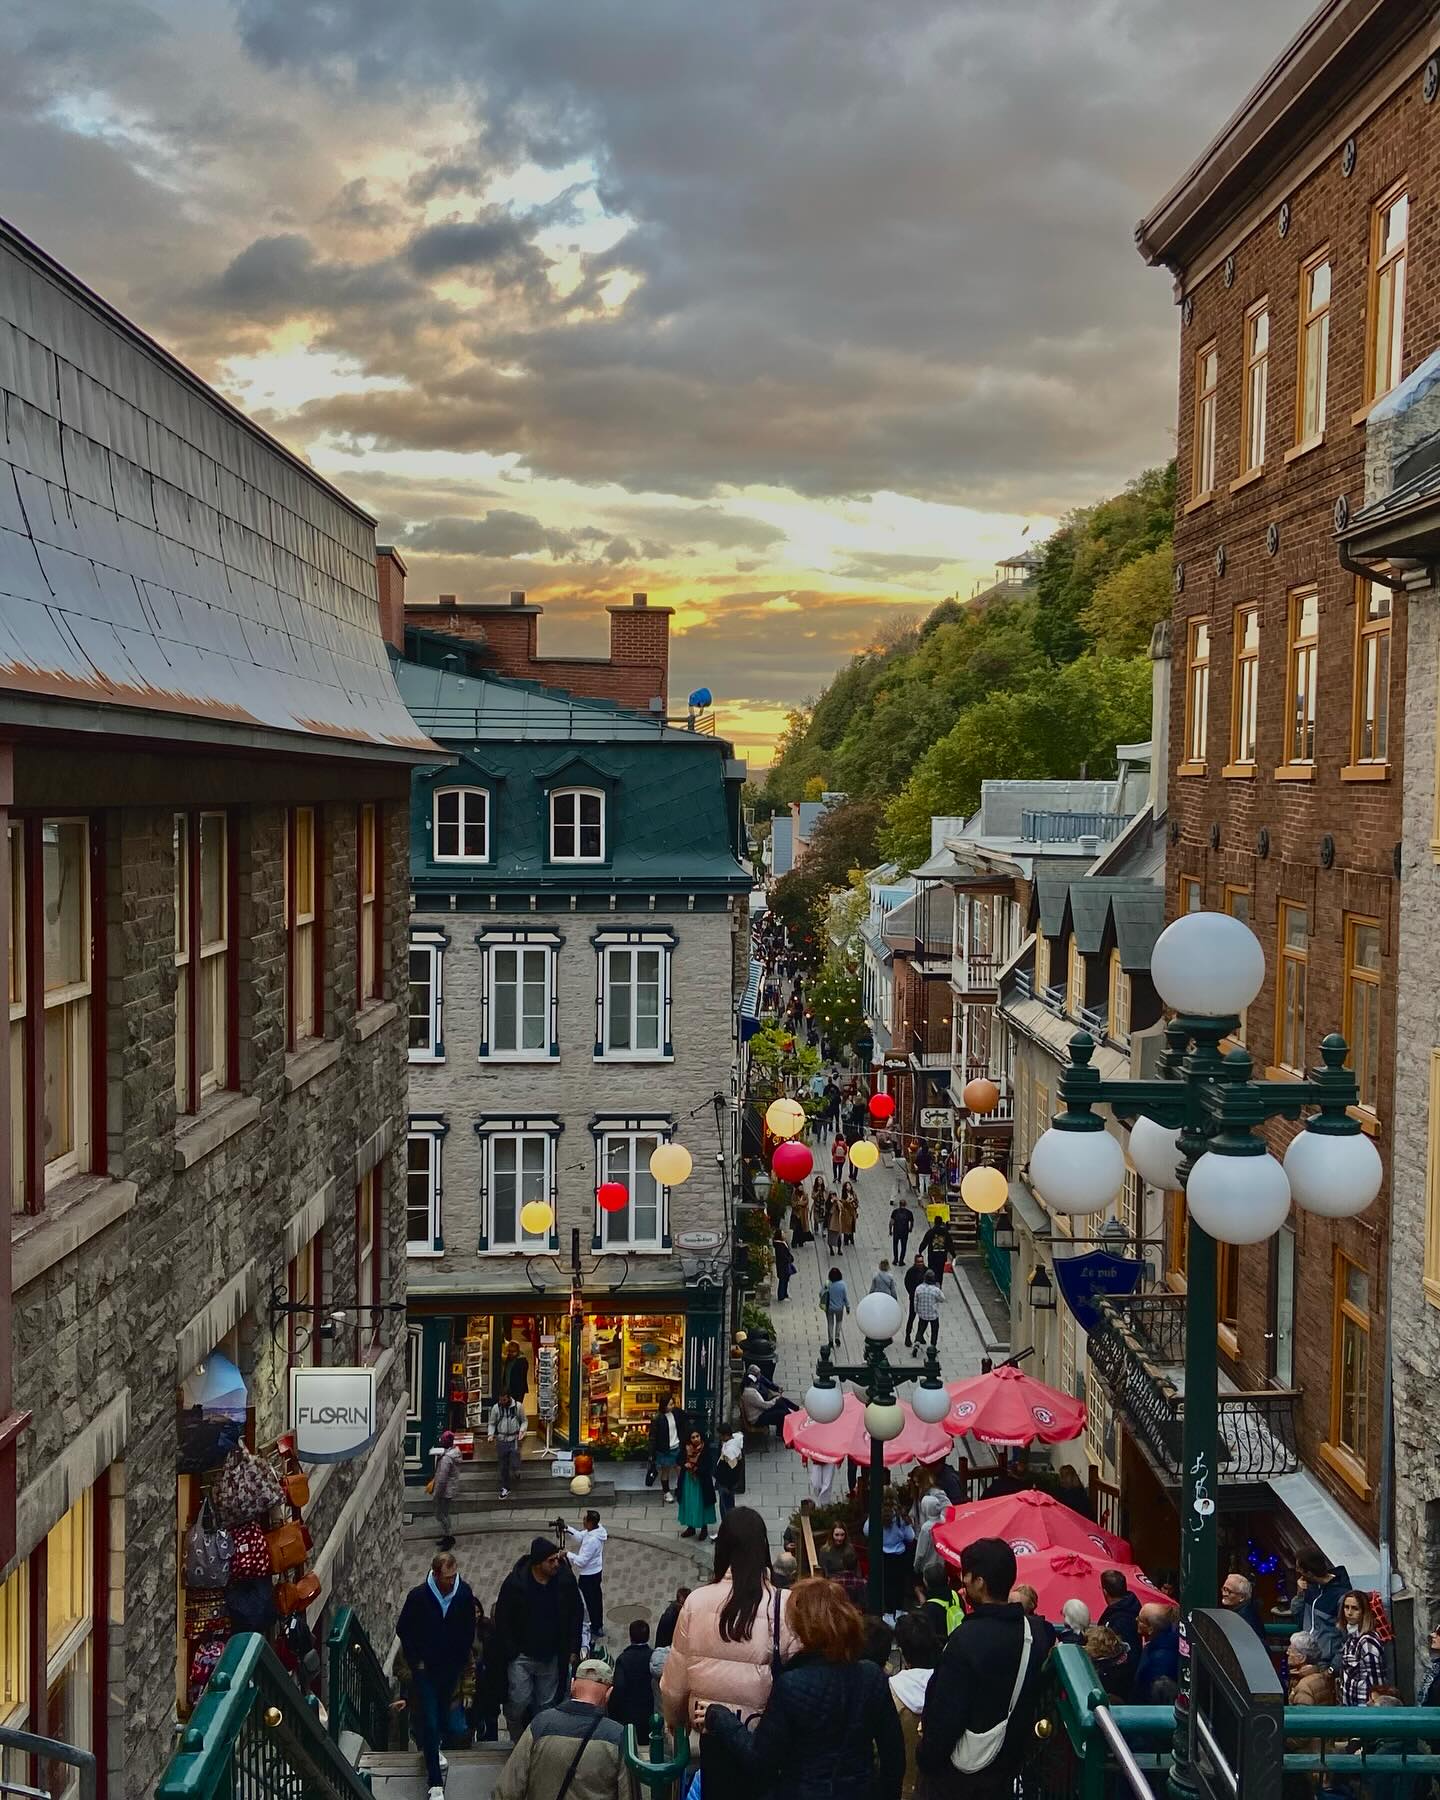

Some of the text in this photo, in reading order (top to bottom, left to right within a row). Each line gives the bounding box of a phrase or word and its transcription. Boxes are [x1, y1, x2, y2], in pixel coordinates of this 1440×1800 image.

[1080, 1266, 1117, 1278] Le pub
[298, 1406, 368, 1425] FLORIN
